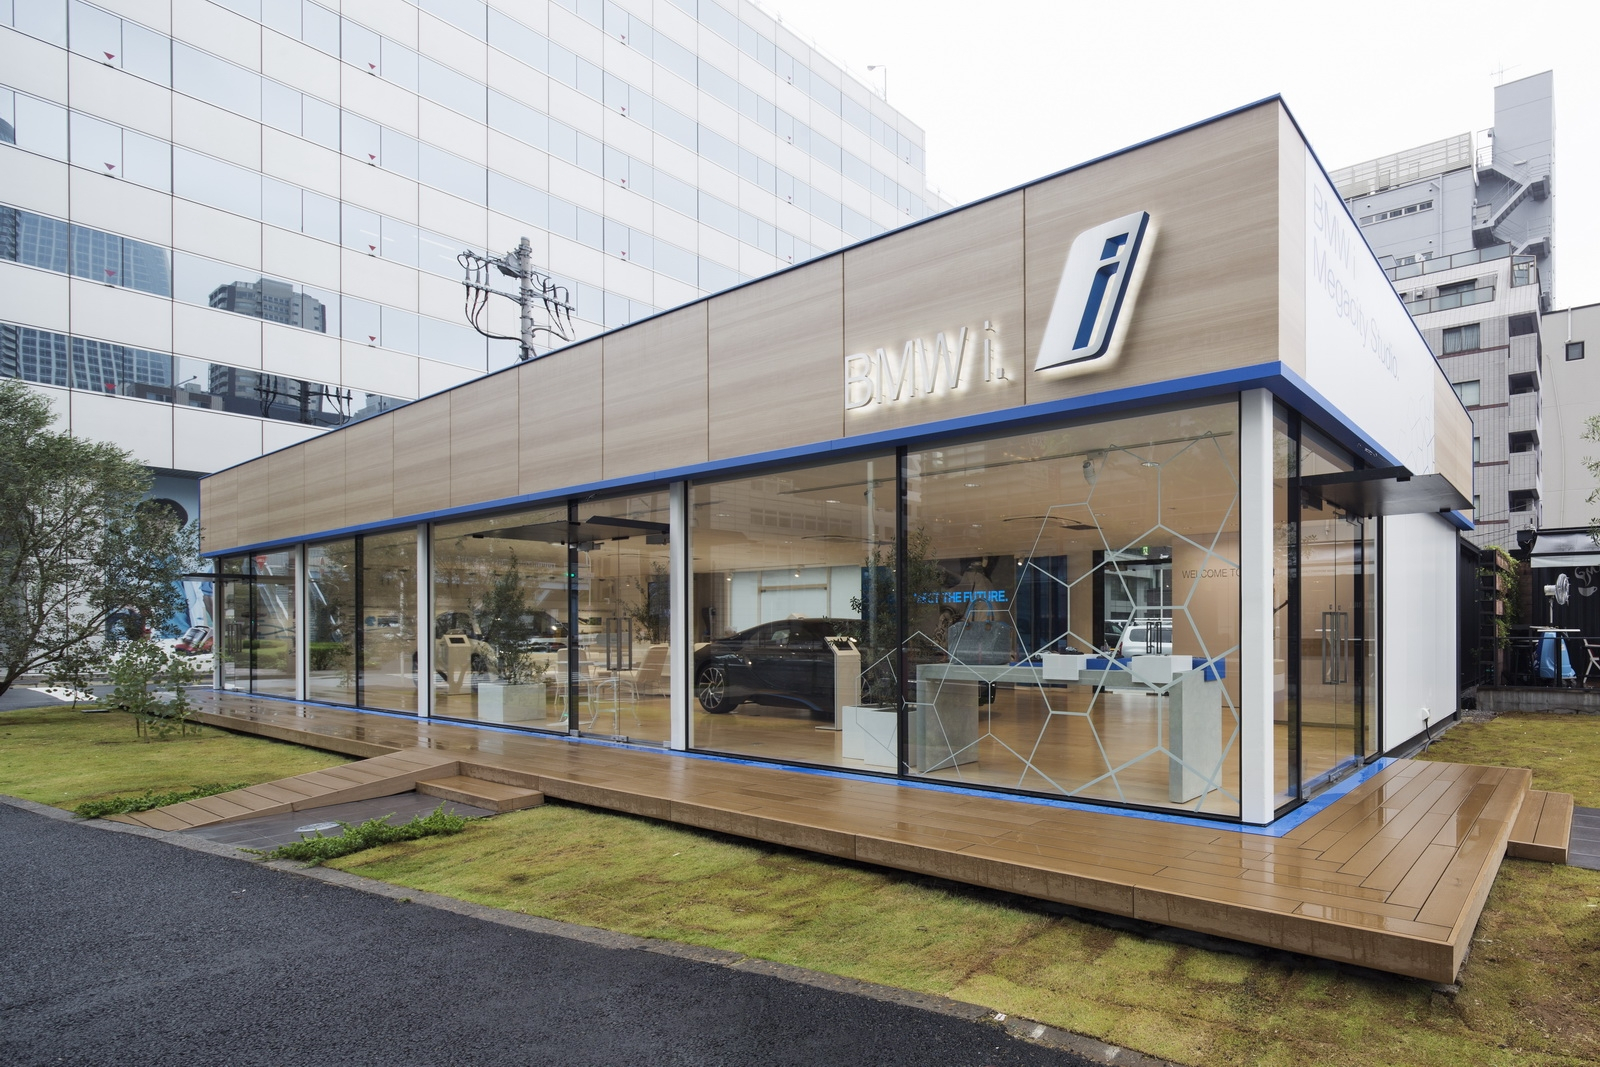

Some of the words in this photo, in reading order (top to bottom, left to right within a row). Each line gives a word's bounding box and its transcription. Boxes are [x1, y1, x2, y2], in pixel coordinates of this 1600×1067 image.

[1313, 183, 1351, 270] BMW
[1313, 236, 1369, 348] Megacity
[845, 326, 968, 410] BMW
[942, 591, 962, 603] THE
[1182, 569, 1228, 579] WELCOME
